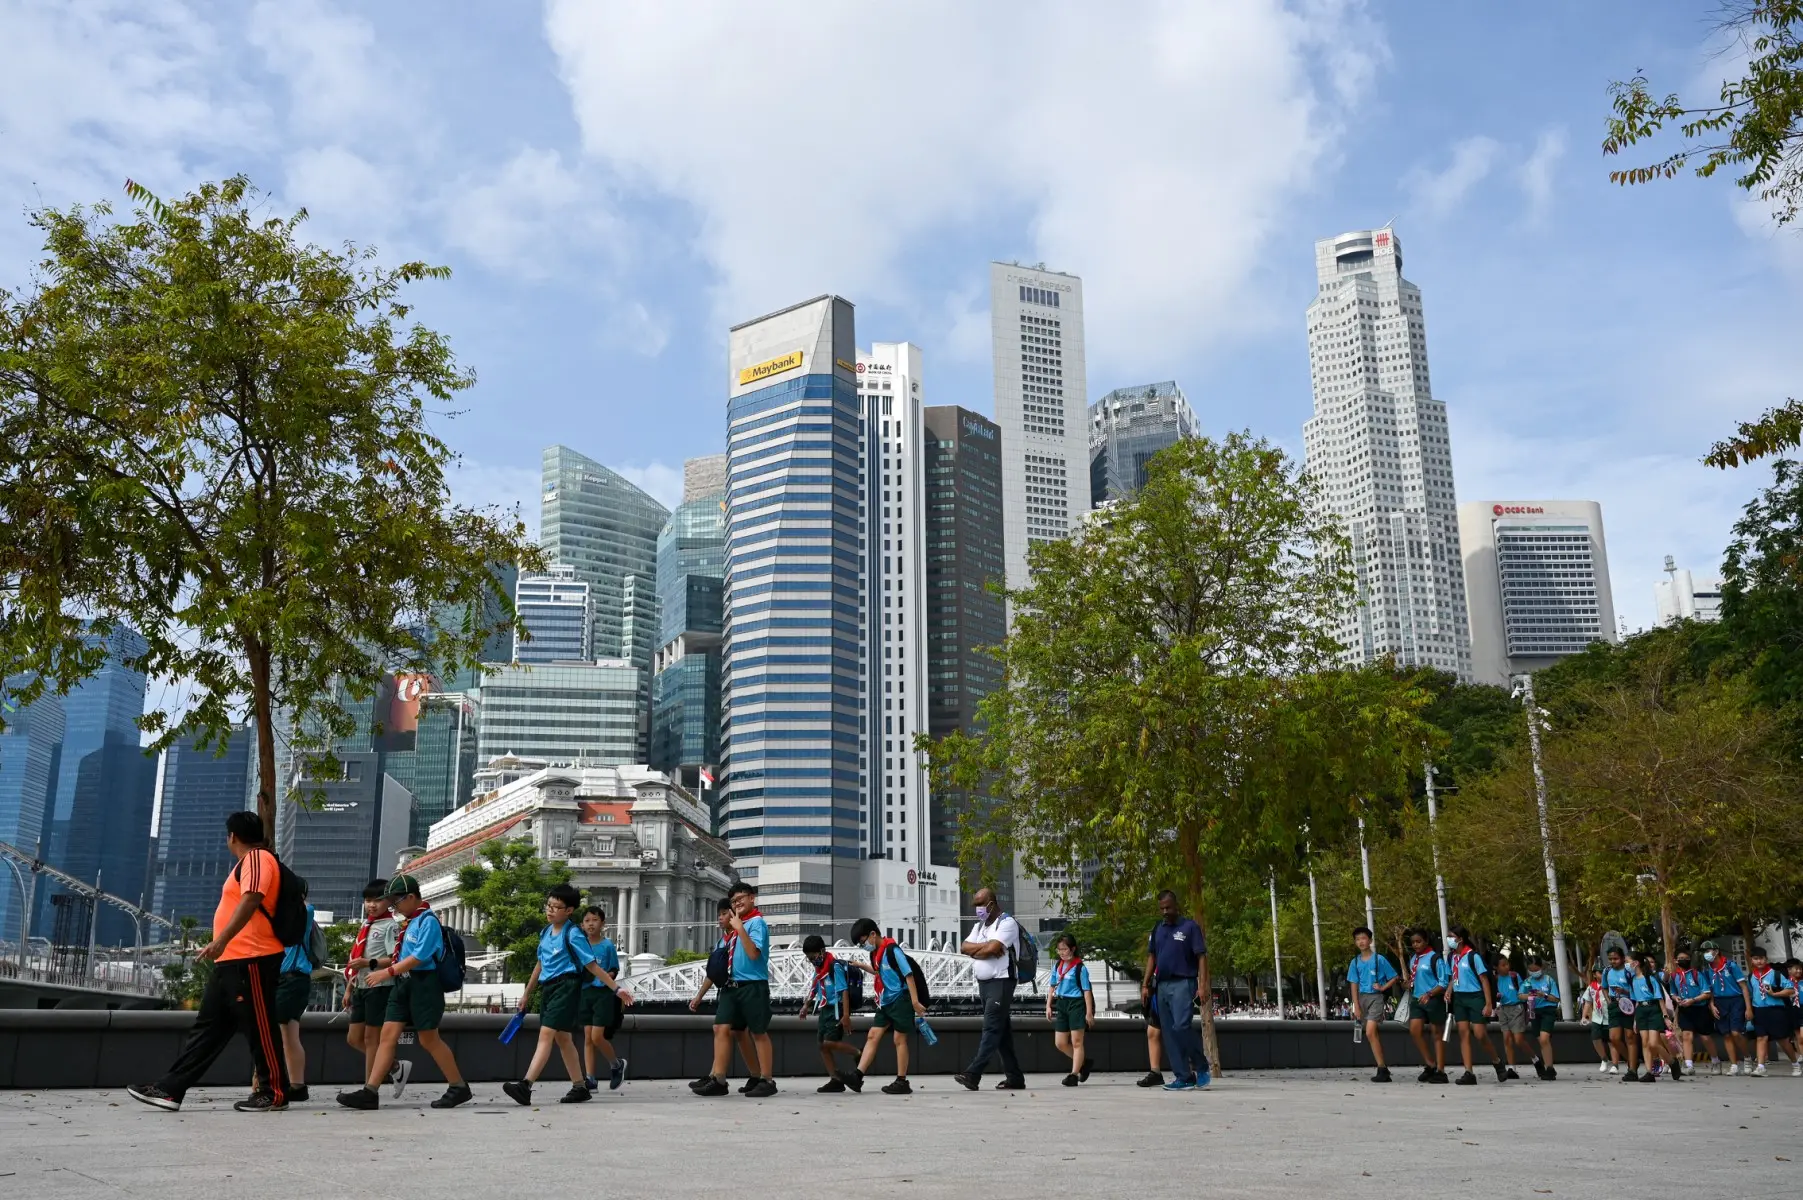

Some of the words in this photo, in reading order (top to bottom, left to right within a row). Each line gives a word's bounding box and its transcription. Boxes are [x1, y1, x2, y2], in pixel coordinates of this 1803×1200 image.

[1374, 247, 1394, 257] UOB
[752, 356, 795, 377] Maybank
[584, 473, 608, 485] Keppel
[1504, 506, 1526, 514] OCBC
[1526, 506, 1544, 514] Bank
